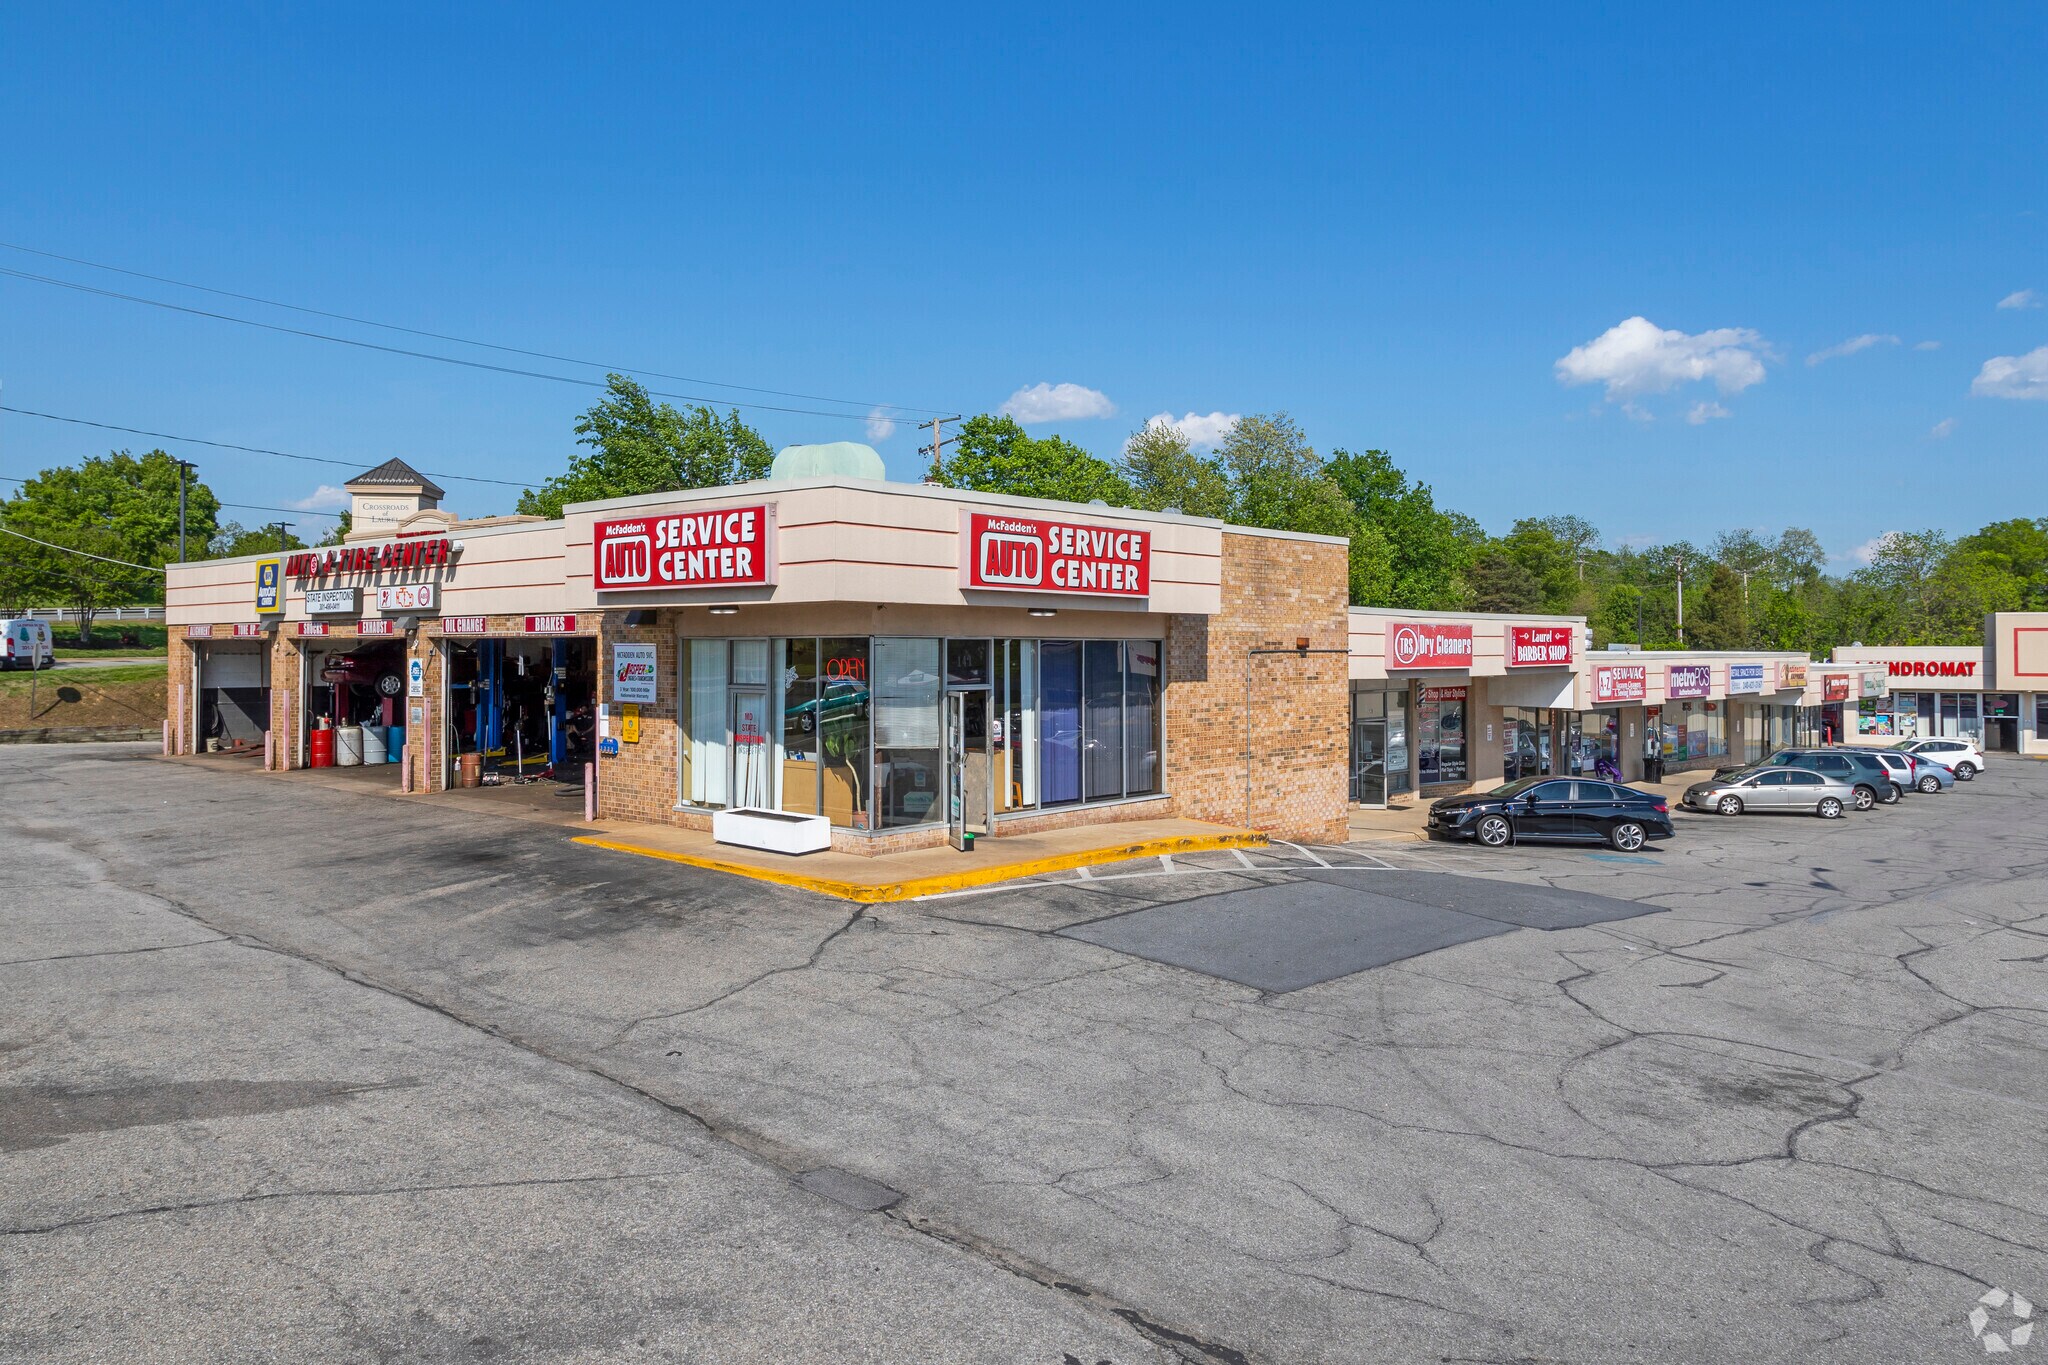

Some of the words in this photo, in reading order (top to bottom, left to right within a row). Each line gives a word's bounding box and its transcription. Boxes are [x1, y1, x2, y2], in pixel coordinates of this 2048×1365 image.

[362, 502, 409, 511] CROSSROADS
[605, 522, 646, 536] McFadden's
[655, 511, 756, 549] SERVICE
[987, 518, 1037, 534] McFadden's
[1048, 525, 1142, 561] SERVICE
[285, 553, 318, 577] AUTO
[323, 549, 335, 573] &
[338, 545, 376, 572] TIRE
[380, 538, 449, 569] CENTER
[604, 539, 647, 579] AUTO
[657, 546, 754, 582] CENTER
[985, 538, 1038, 579] AUTO
[1051, 558, 1139, 591] CENTER
[307, 592, 322, 603] STATE
[321, 591, 354, 602] INSPECTIONS
[362, 620, 387, 634] EXHAUST
[445, 617, 456, 633] OIL
[456, 617, 484, 632] CHANGE
[534, 616, 565, 632] BRAKES
[1531, 629, 1552, 643] Laurel
[1400, 637, 1413, 655] TRS
[1419, 634, 1434, 658] Dry
[1436, 634, 1472, 655] Cleaners
[1517, 645, 1548, 662] BARBER
[1548, 645, 1568, 661] SHOP
[826, 658, 866, 681] OPEN
[1612, 667, 1645, 680] SEW-VAC
[1670, 667, 1710, 687] metroPCS
[1427, 689, 1439, 699] Shop
[1444, 688, 1452, 698] Hair
[1452, 688, 1466, 700] Stylists
[741, 723, 757, 733] STATE
